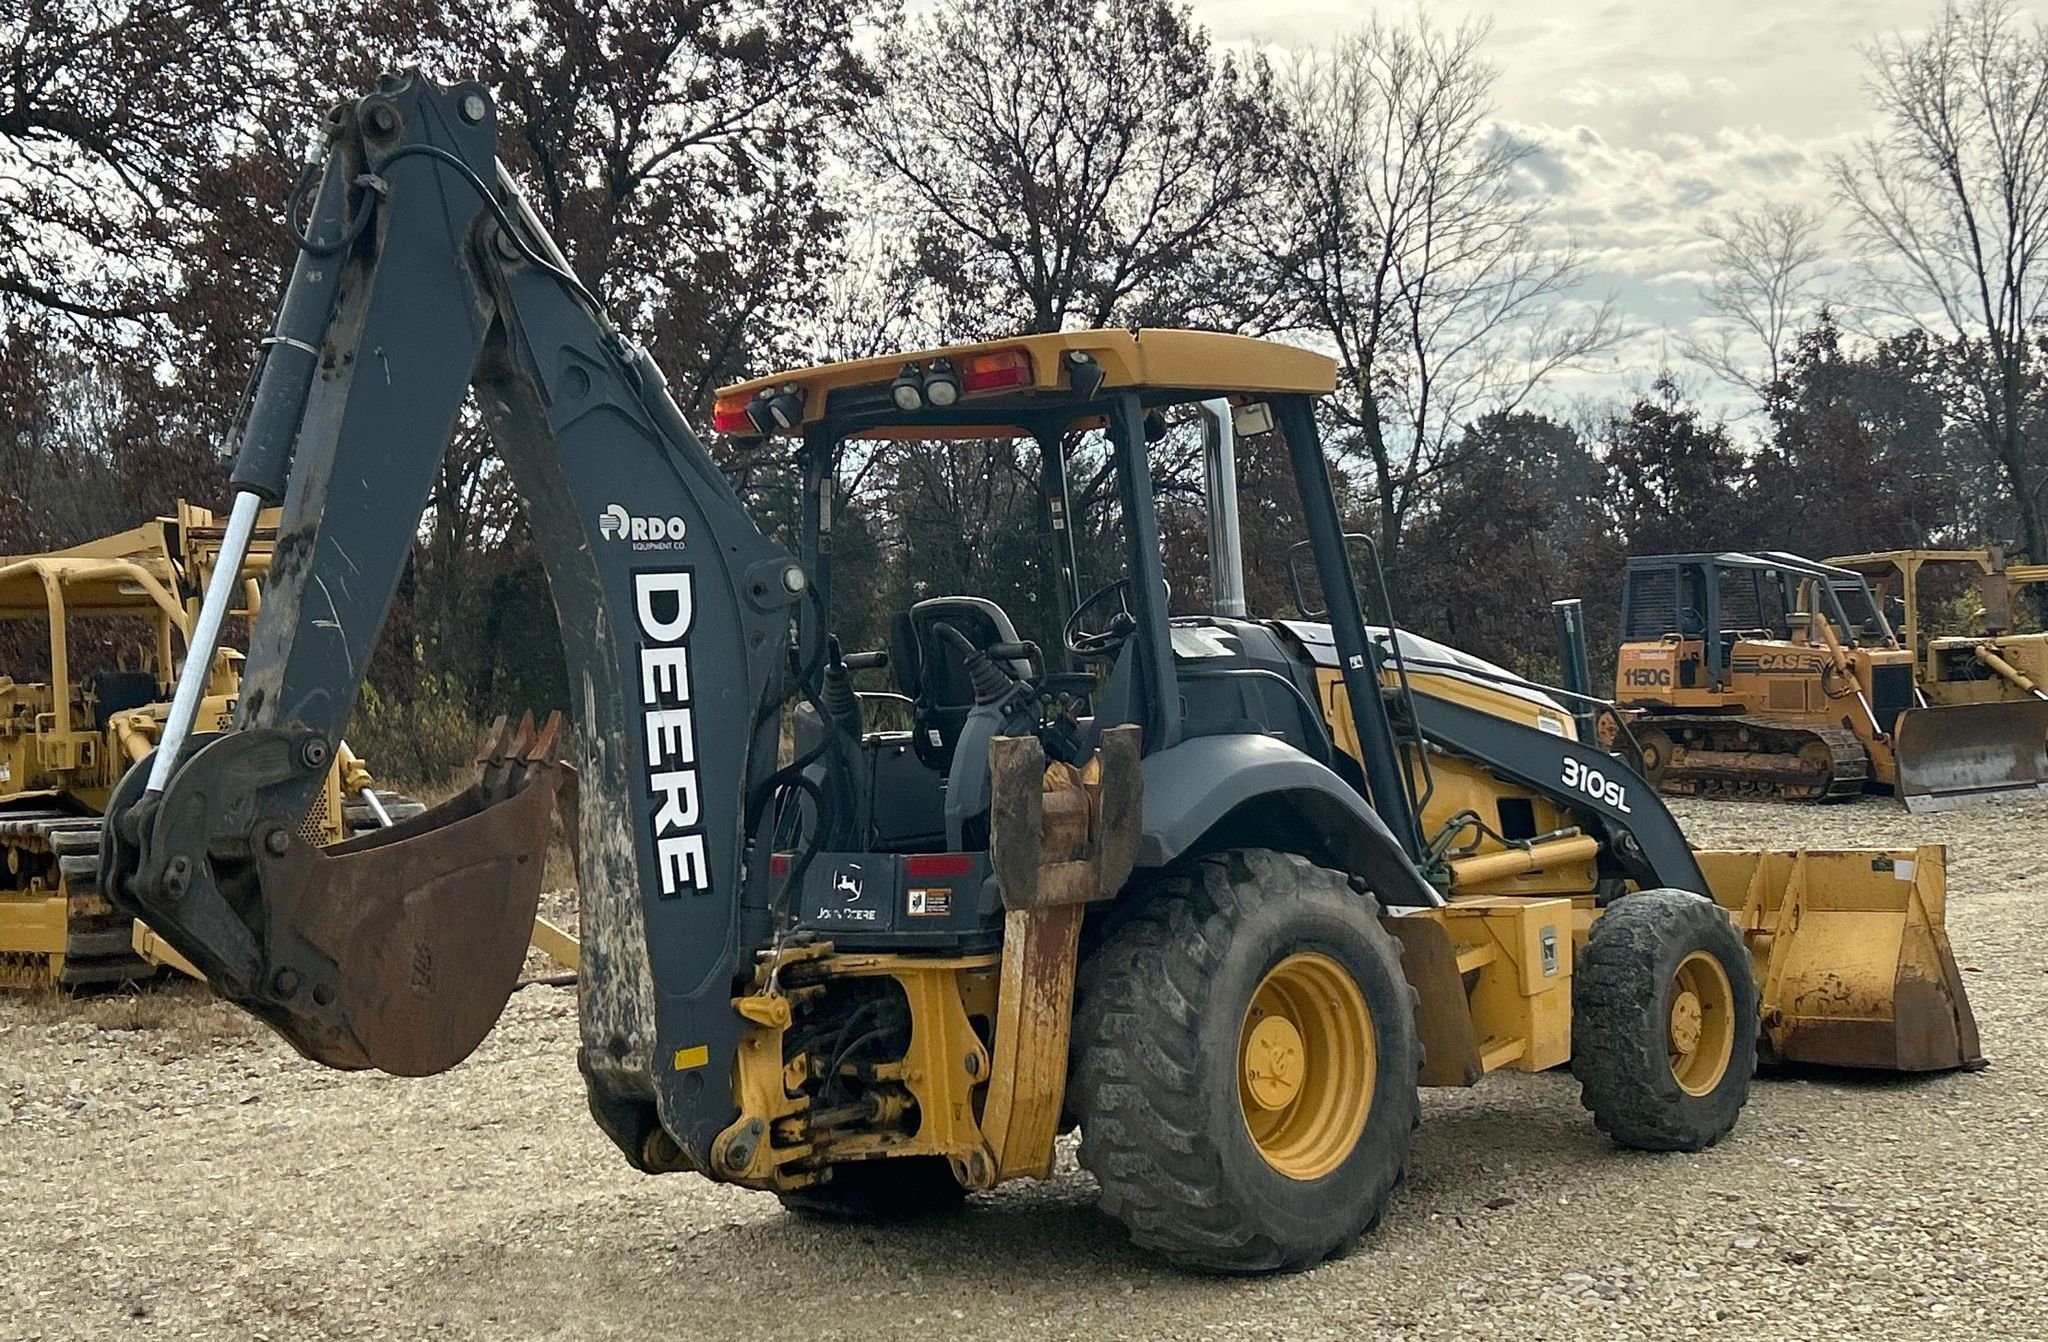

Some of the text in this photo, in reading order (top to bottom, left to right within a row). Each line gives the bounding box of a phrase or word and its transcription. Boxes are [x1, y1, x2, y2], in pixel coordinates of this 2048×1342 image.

[631, 516, 686, 541] RDO
[632, 542, 672, 551] EQUIPMENT
[1758, 654, 1812, 669] CASE
[1624, 668, 1671, 686] 1150G
[635, 572, 709, 895] DEERE
[1561, 757, 1631, 813] 310SL
[816, 907, 842, 919] JO
